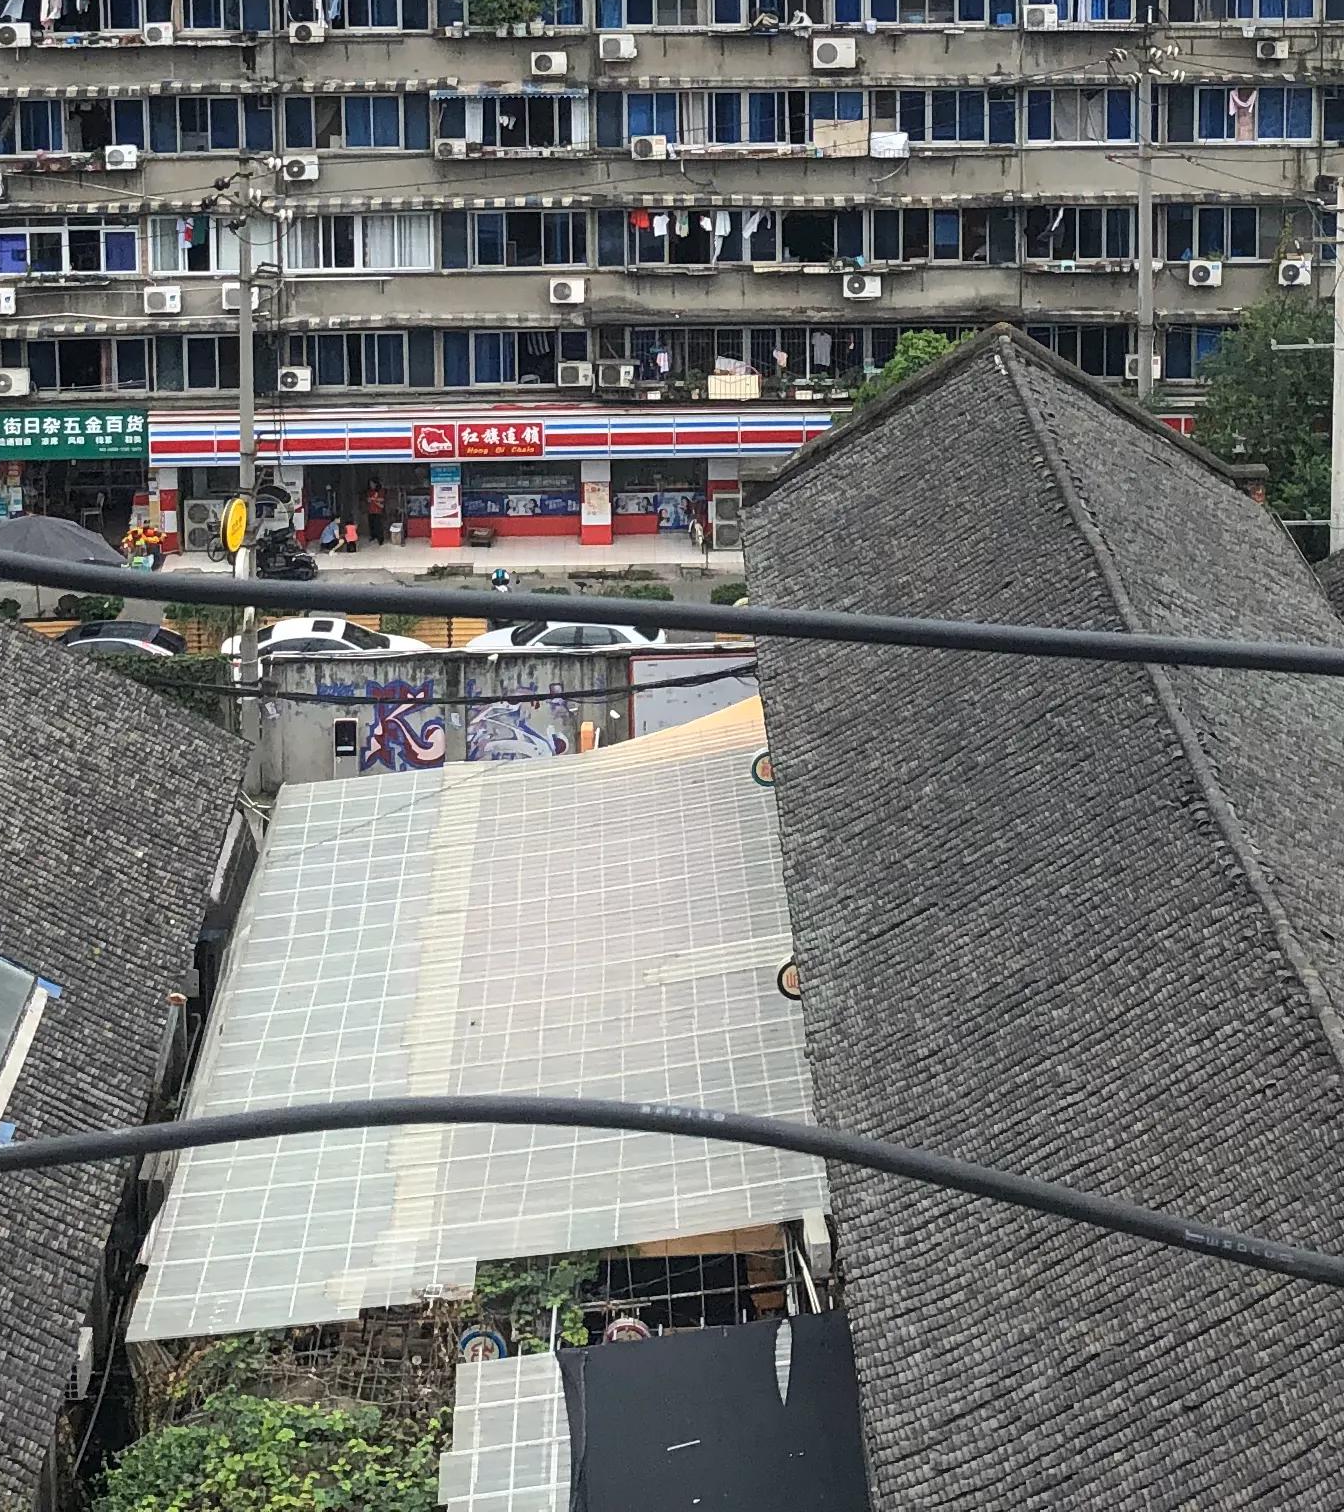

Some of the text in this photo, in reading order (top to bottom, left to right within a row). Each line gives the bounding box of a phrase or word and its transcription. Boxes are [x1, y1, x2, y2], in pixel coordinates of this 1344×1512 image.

[461, 426, 541, 445] 红旗连锁
[466, 447, 489, 455] Hong
